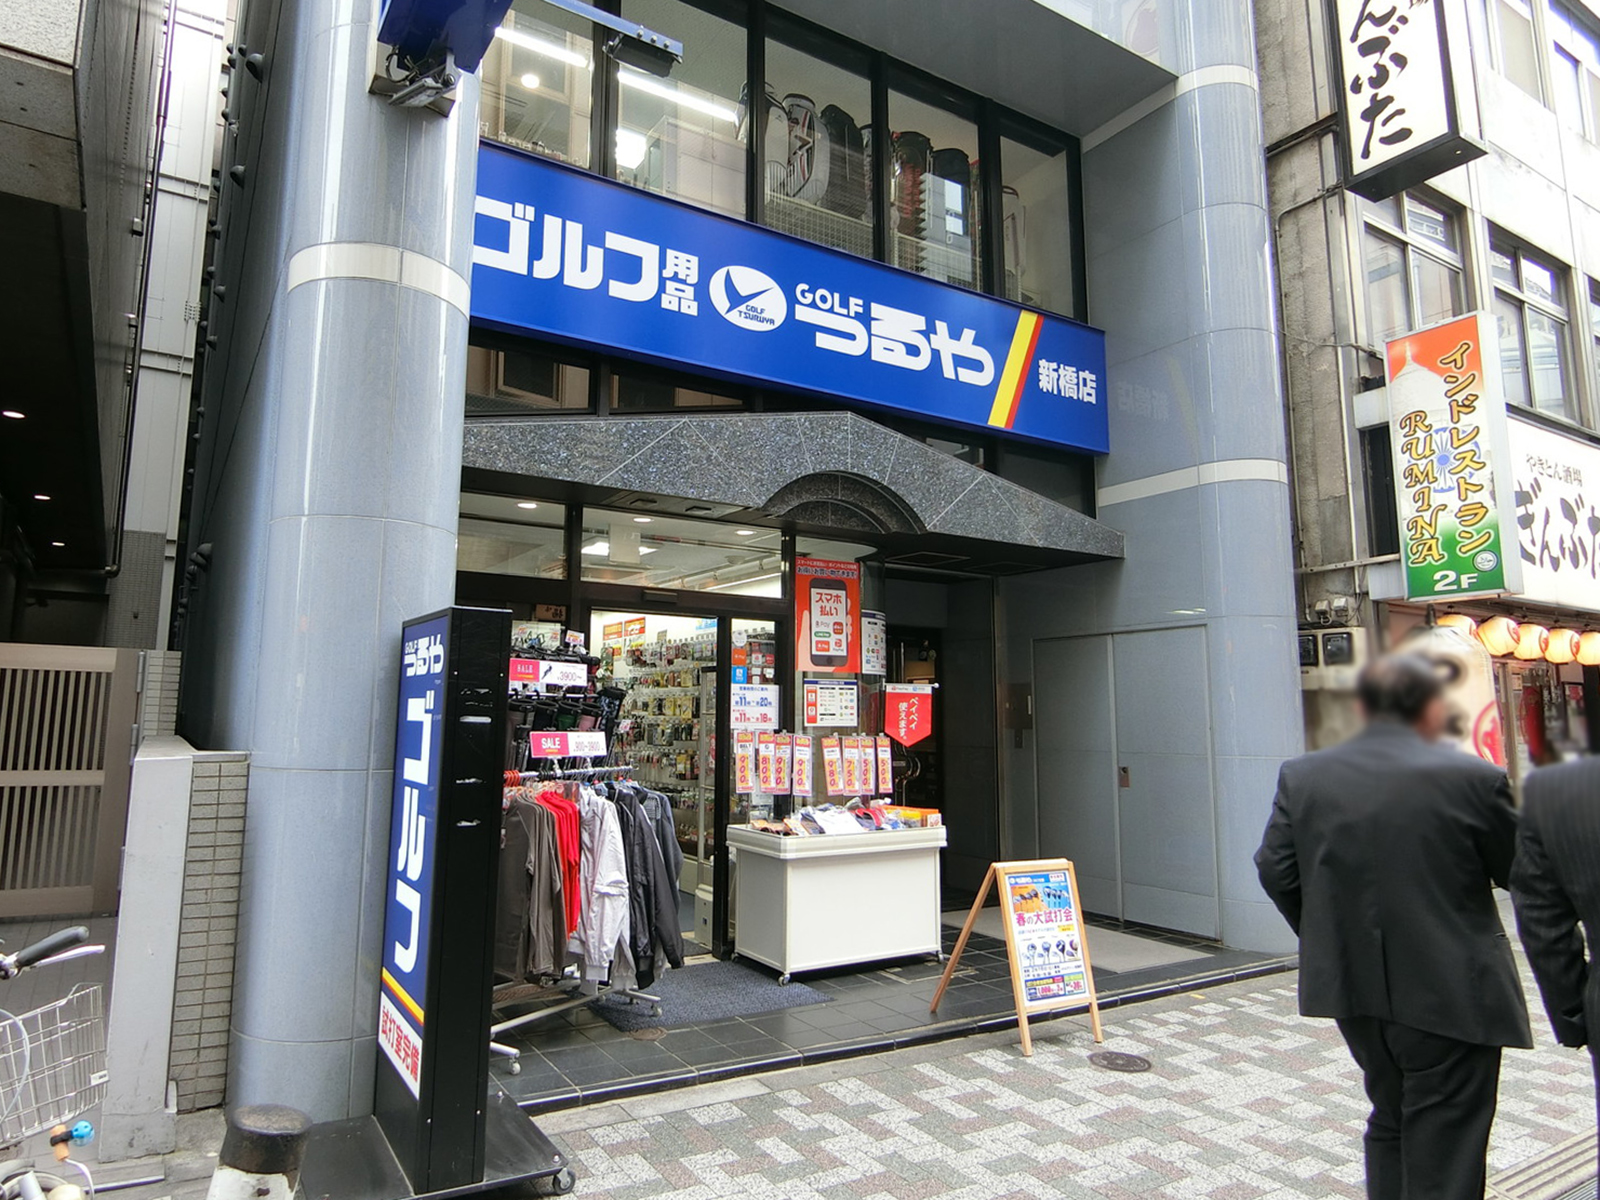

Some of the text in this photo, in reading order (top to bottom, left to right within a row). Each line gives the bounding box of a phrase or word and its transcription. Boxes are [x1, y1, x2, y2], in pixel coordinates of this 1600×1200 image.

[472, 195, 698, 317] ゴルフ 用品
[745, 304, 766, 315] GOLF
[795, 283, 863, 317] GOLF
[737, 310, 775, 326] TSURUYA
[795, 303, 995, 387] つるや
[1038, 358, 1096, 404] 新橋店
[1440, 342, 1490, 555] インドレストラン
[1400, 410, 1447, 564] RUMINA
[1526, 453, 1583, 487] やきとん酒場
[1433, 570, 1478, 591] 2F
[815, 592, 842, 605] スマホ
[820, 605, 838, 617] 払い
[404, 633, 444, 677] つるや
[517, 664, 533, 674] SALE
[909, 696, 919, 730] ペイペイ
[541, 737, 560, 749] SALE
[394, 690, 435, 973] ゴルフ
[1015, 908, 1073, 927] 春の大試打会
[382, 1005, 419, 1083] 試打室完備
